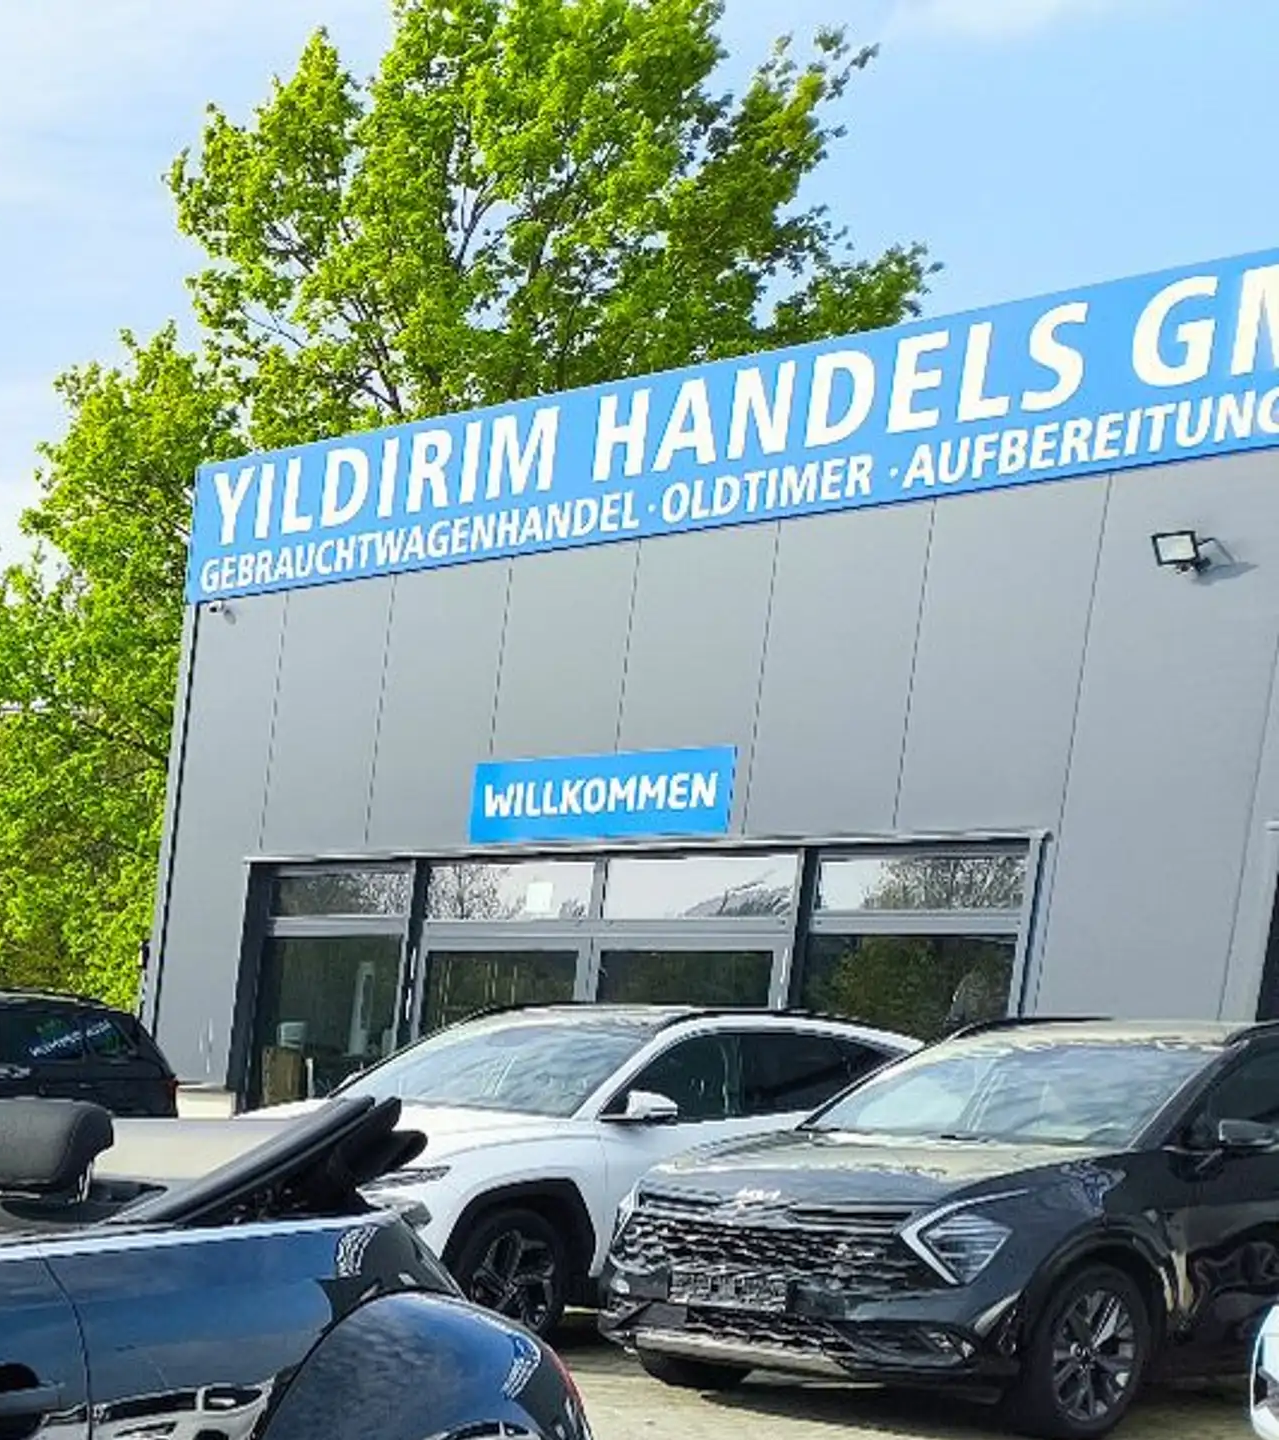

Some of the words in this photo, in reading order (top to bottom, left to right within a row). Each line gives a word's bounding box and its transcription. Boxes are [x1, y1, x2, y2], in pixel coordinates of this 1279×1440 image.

[212, 404, 560, 546] YILDIRIM
[592, 301, 1088, 482] HANDELS
[200, 491, 639, 594] GEBRAUCHTWAGENHANDEL
[661, 453, 873, 524] OLDTIMER
[484, 772, 718, 818] WILLKOMMEN
